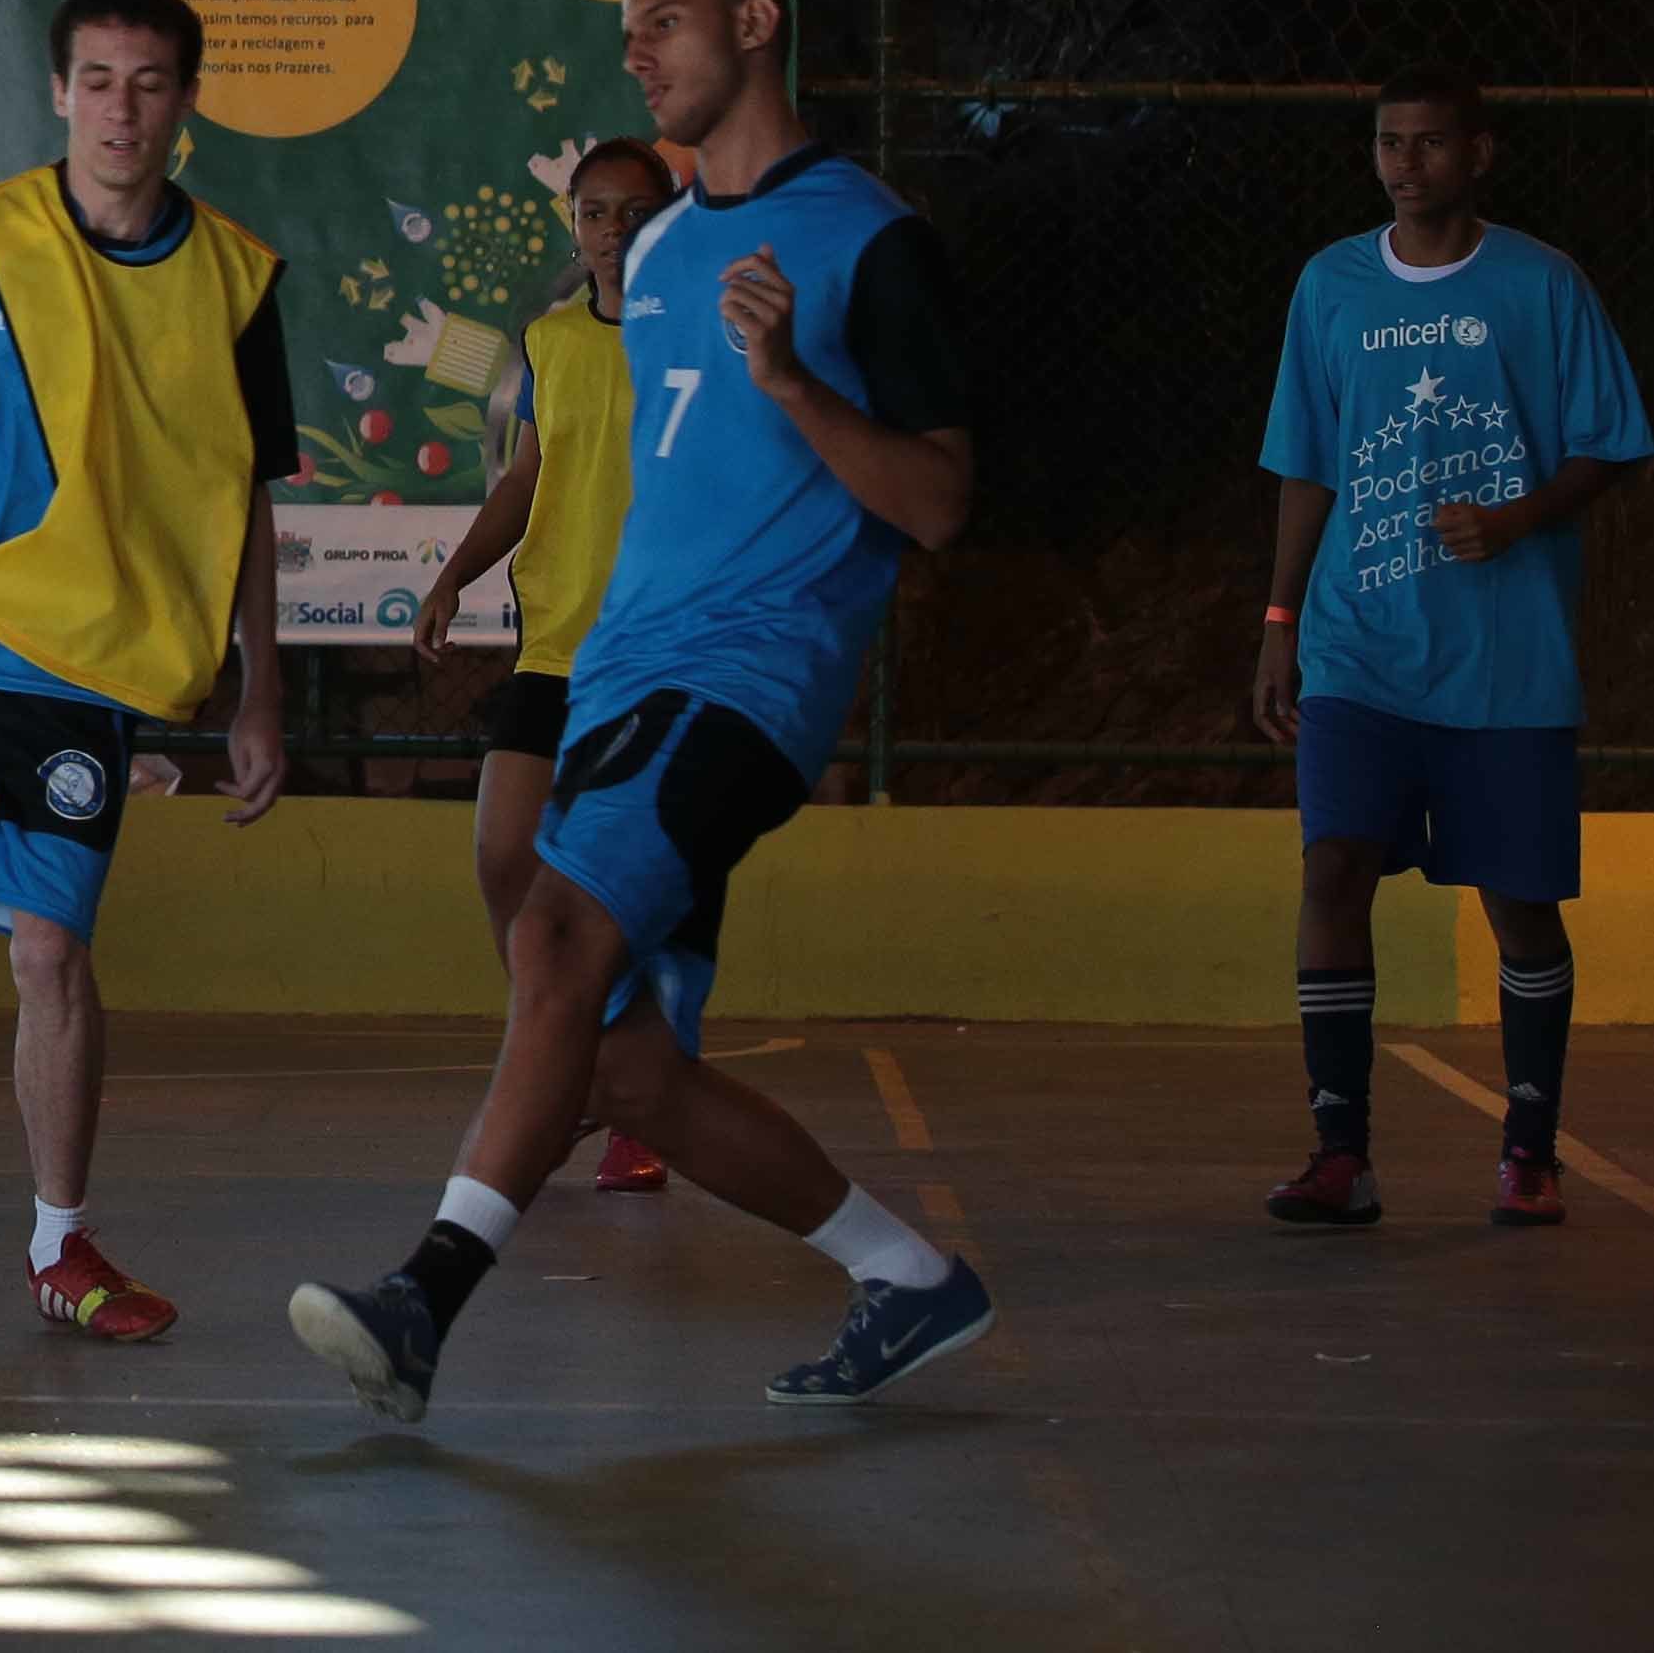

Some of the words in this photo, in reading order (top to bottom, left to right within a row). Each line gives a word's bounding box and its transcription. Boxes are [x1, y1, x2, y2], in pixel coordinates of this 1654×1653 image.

[235, 13, 278, 26] temos
[281, 14, 338, 26] recursos
[345, 15, 375, 28] para
[230, 39, 239, 50] a
[242, 37, 315, 52] reciclagem
[316, 39, 326, 50] e
[247, 63, 272, 74] nos
[1363, 314, 1451, 352] unicef
[654, 368, 701, 458] 7
[1349, 434, 1526, 514] Podemos
[1352, 509, 1409, 552] ser
[323, 548, 370, 562] GRUPO
